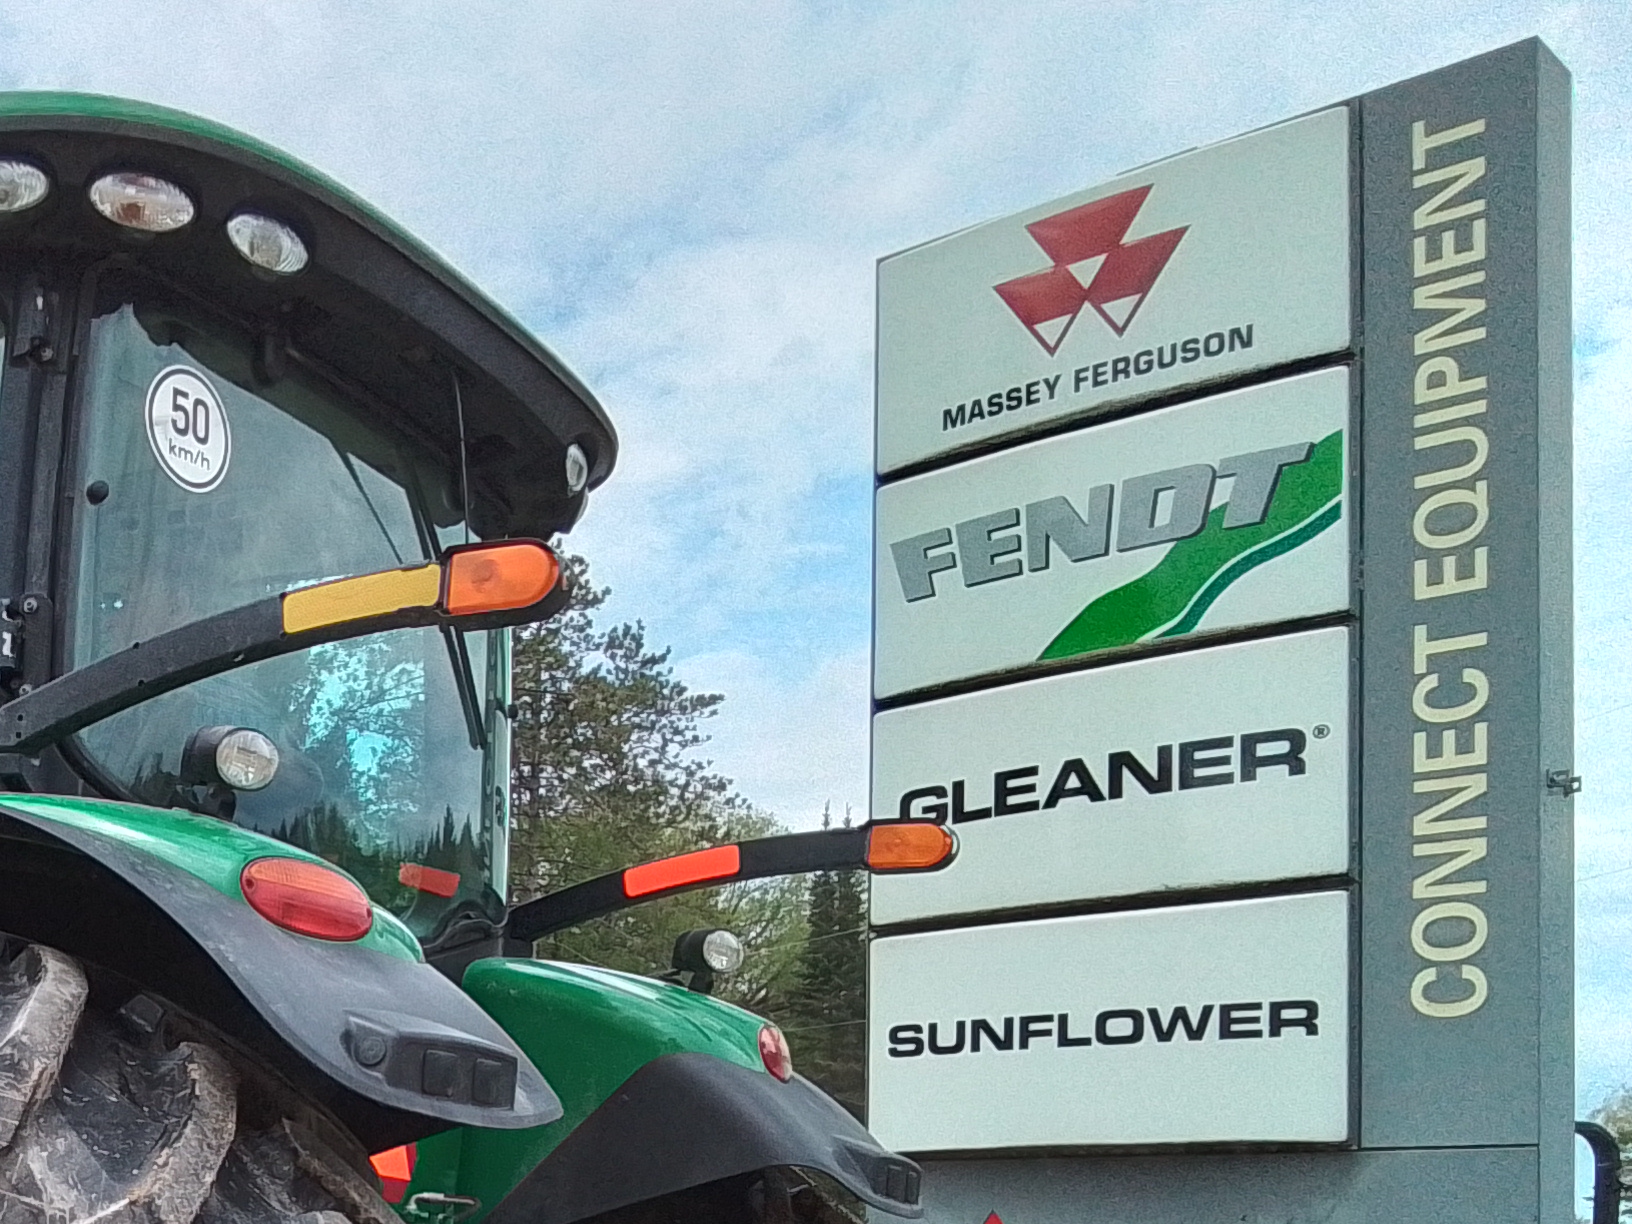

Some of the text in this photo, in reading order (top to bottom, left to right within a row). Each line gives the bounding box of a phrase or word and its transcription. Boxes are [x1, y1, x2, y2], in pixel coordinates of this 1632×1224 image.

[171, 386, 210, 445] 50
[941, 324, 1255, 432] MASSEY FERGUSON
[168, 437, 211, 471] km/h
[889, 441, 1315, 603] FENDT
[1410, 118, 1490, 1019] CONNECT EQUIPMENT
[888, 999, 1320, 1059] SUNFLOWER
